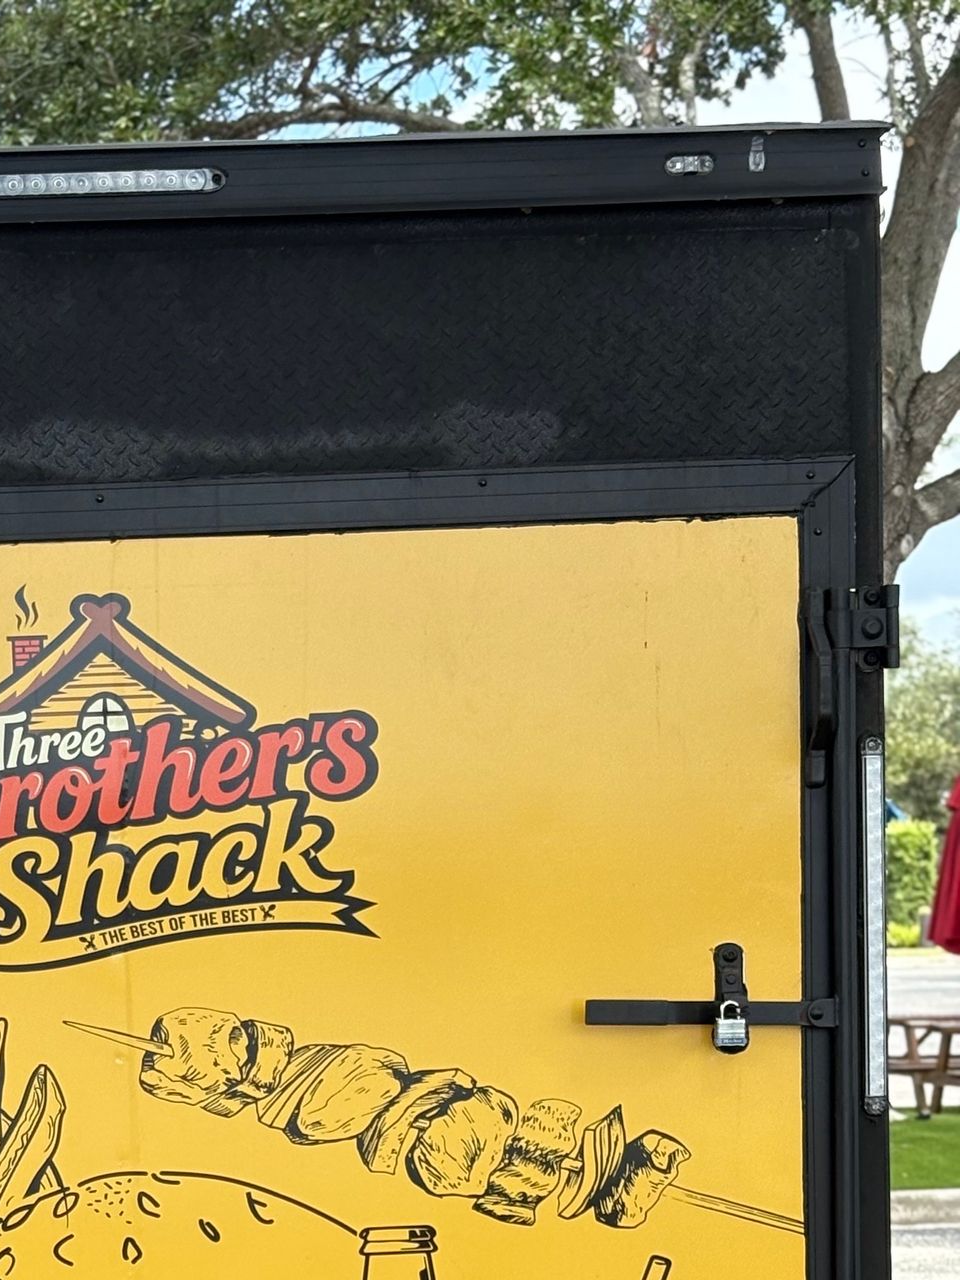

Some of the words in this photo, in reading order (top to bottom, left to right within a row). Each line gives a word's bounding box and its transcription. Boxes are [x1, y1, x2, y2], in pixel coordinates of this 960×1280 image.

[99, 928, 128, 946] THE
[130, 919, 166, 939] BEST
[169, 915, 186, 932] OF
[191, 911, 219, 928] THE
[222, 907, 258, 924] BEST
